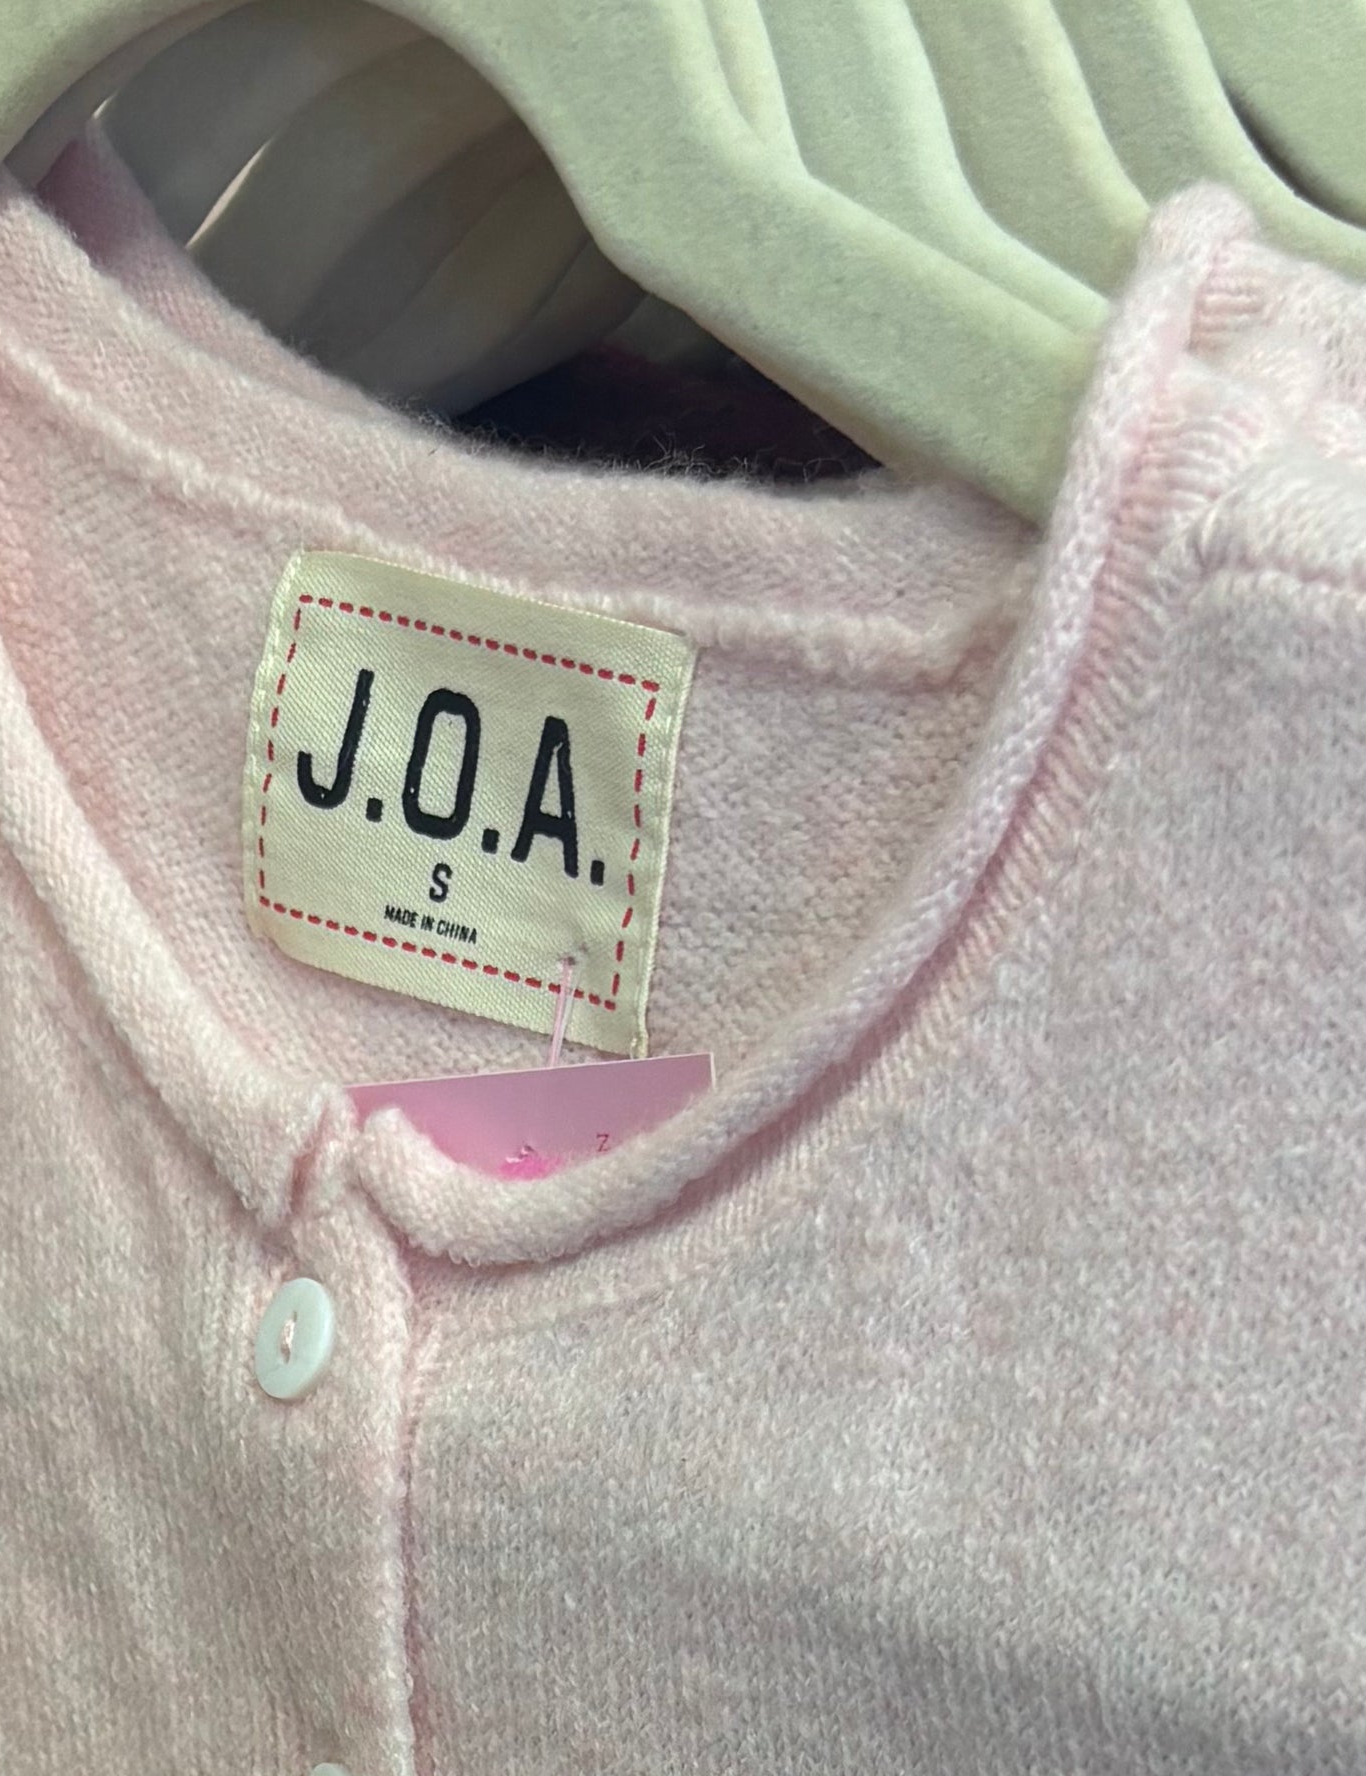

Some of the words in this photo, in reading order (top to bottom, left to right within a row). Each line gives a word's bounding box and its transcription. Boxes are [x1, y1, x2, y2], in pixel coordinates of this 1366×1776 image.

[296, 669, 605, 886] J.O.A.
[429, 863, 453, 902] S
[383, 904, 419, 928] MADE
[420, 914, 435, 932] IN
[436, 919, 477, 944] CHINA
